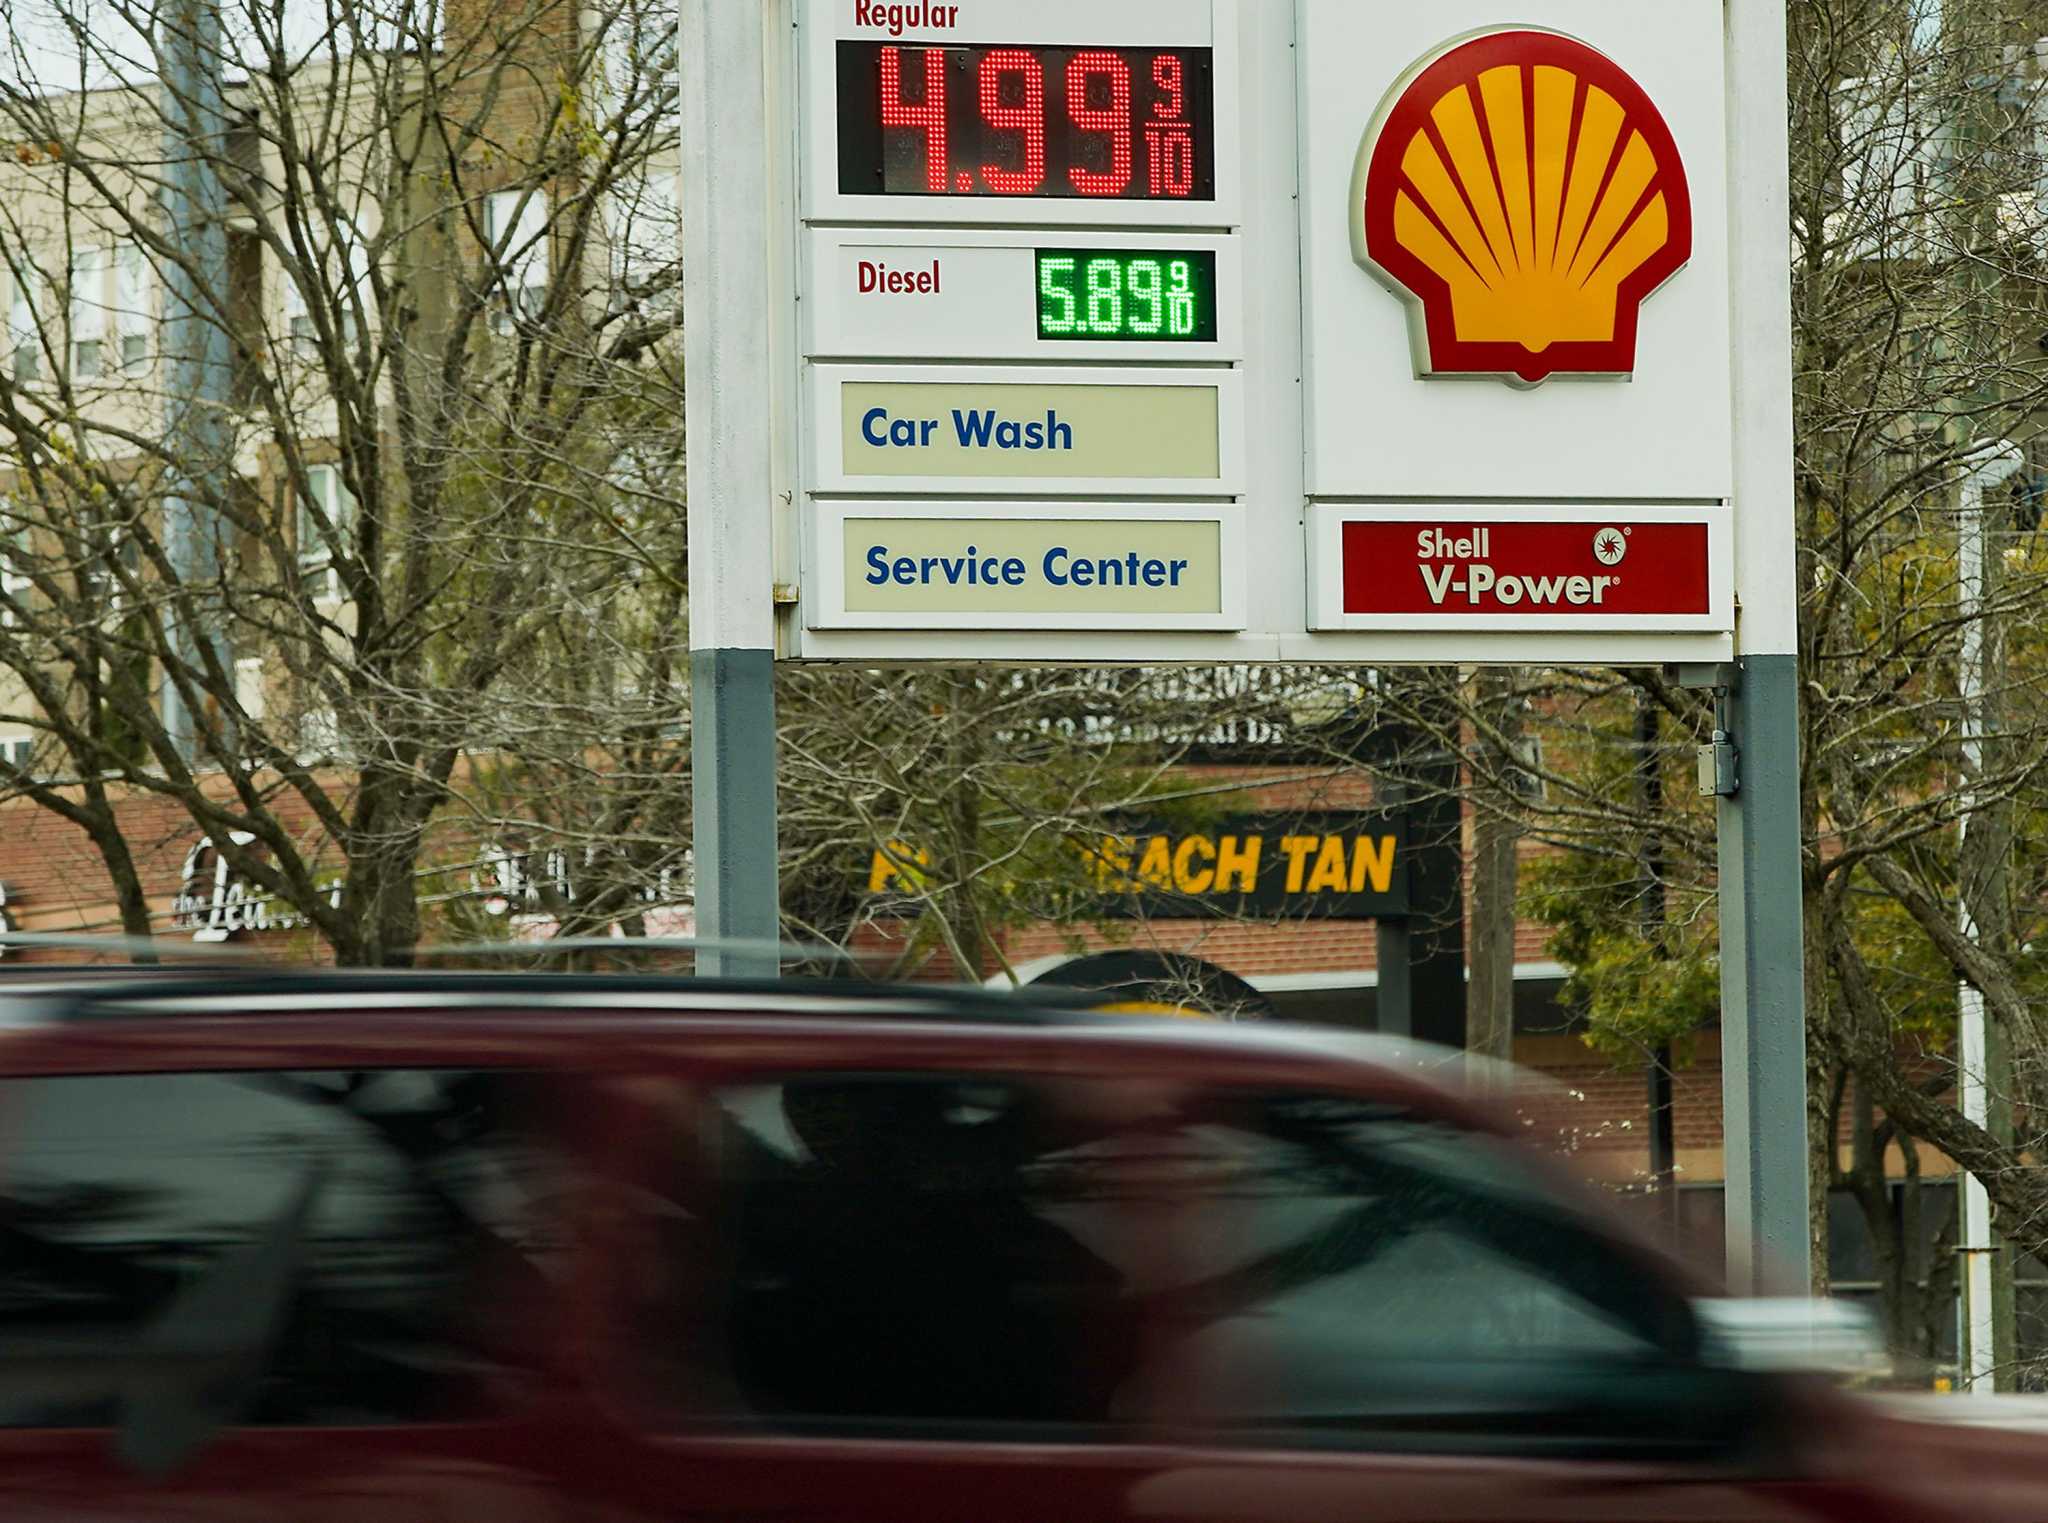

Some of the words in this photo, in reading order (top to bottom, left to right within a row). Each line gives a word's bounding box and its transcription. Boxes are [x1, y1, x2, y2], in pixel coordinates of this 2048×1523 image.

[855, 0, 959, 36] Regular
[880, 46, 1132, 194] 4.99
[857, 260, 941, 294] Diesel
[1040, 258, 1162, 334] 5.89
[861, 407, 939, 447] Car
[951, 408, 1073, 450] Wash
[1417, 528, 1489, 559] Shell
[865, 545, 1026, 586] Service
[1042, 546, 1188, 587] Center
[1418, 564, 1612, 605] V-Power
[1076, 835, 1262, 894] EACH
[1280, 835, 1397, 893] TAN
